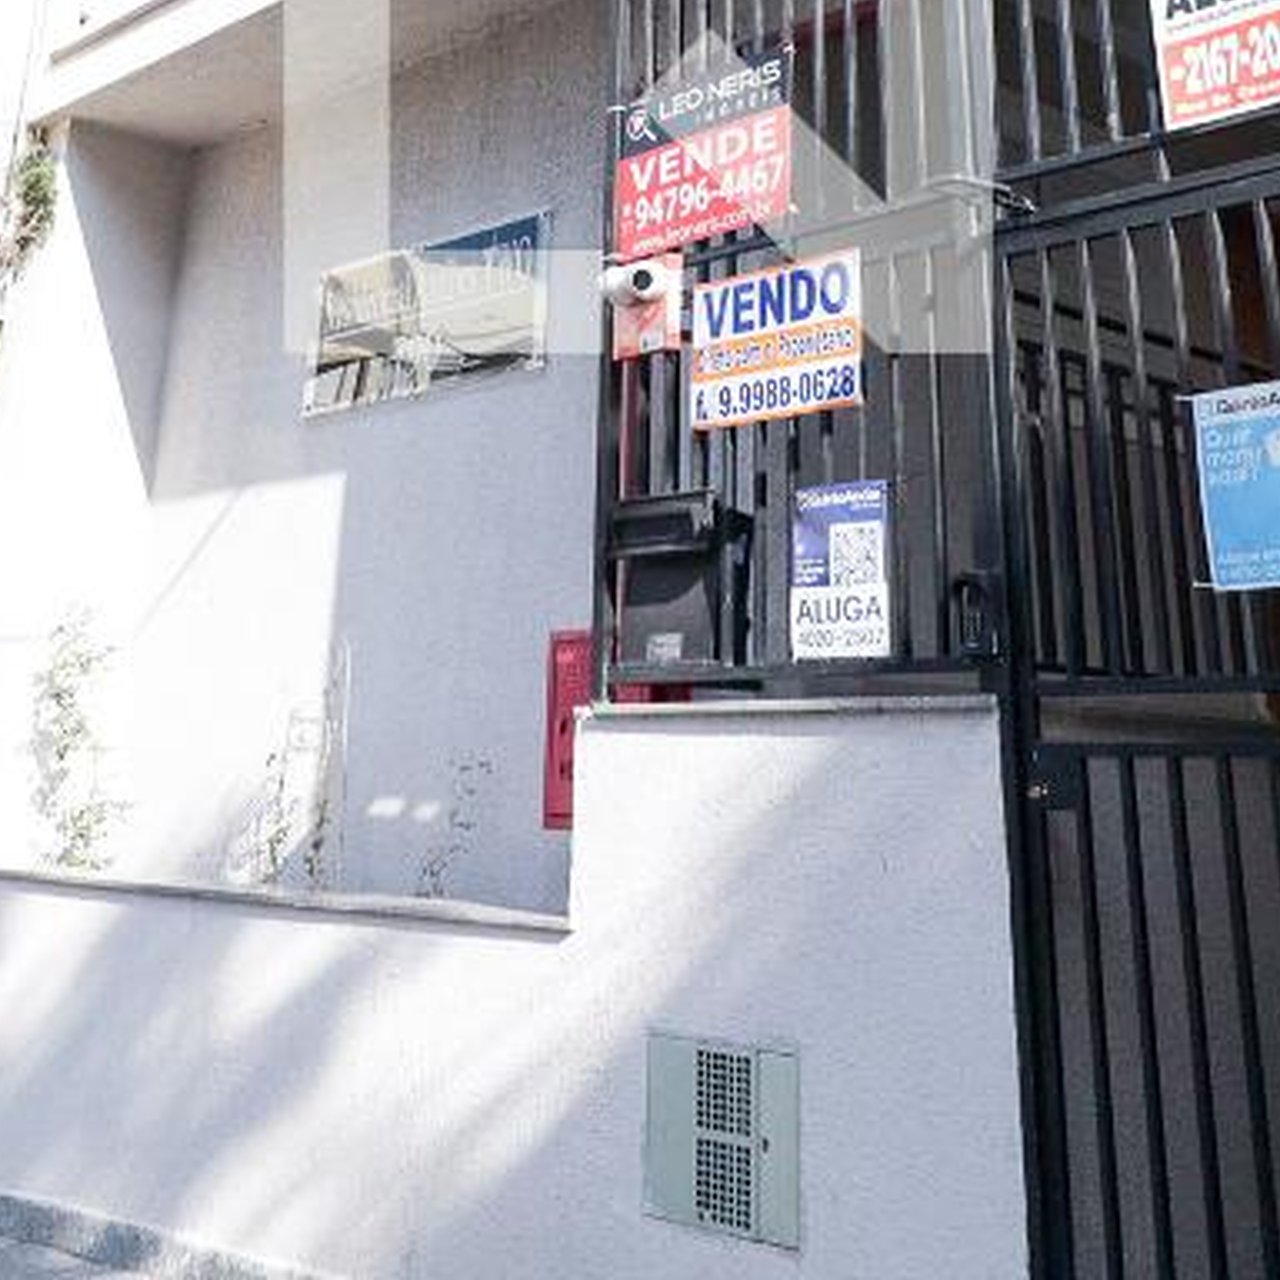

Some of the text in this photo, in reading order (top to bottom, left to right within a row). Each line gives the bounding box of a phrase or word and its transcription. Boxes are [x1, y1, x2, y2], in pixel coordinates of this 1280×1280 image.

[659, 59, 781, 120] LEO NERIS
[629, 113, 778, 192] VENDE
[634, 153, 785, 231] 94796-4467
[703, 261, 850, 338] VENDO
[796, 596, 884, 624] ALUGA
